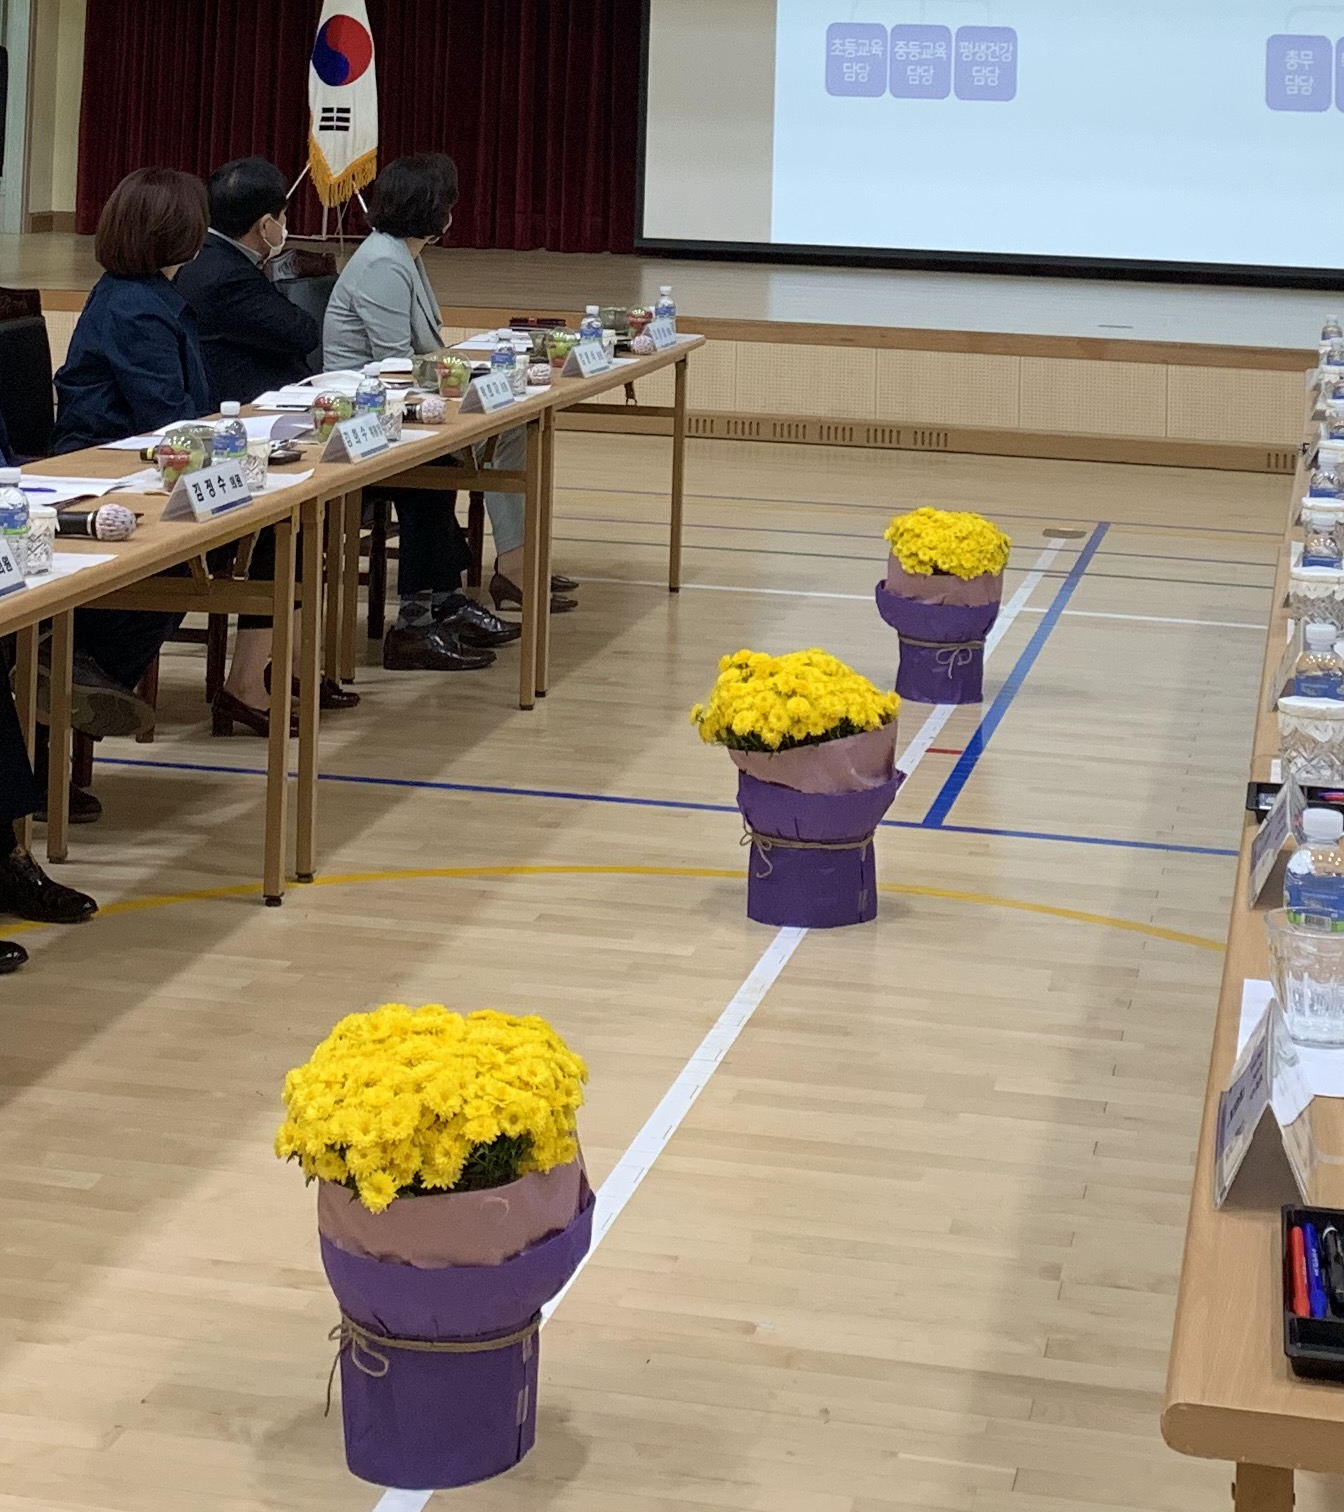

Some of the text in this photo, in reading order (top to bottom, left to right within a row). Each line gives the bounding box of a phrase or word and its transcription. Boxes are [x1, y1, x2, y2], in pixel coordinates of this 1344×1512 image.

[830, 38, 885, 59] 초등교육
[894, 41, 949, 62] 중등교육
[959, 42, 1014, 63] 평생건강
[1285, 49, 1315, 71] 총무
[843, 62, 871, 84] 담당
[906, 65, 934, 87] 담당
[973, 66, 1000, 88] 담당
[1285, 74, 1314, 96] 담당
[192, 473, 244, 502] 김정수 의원
